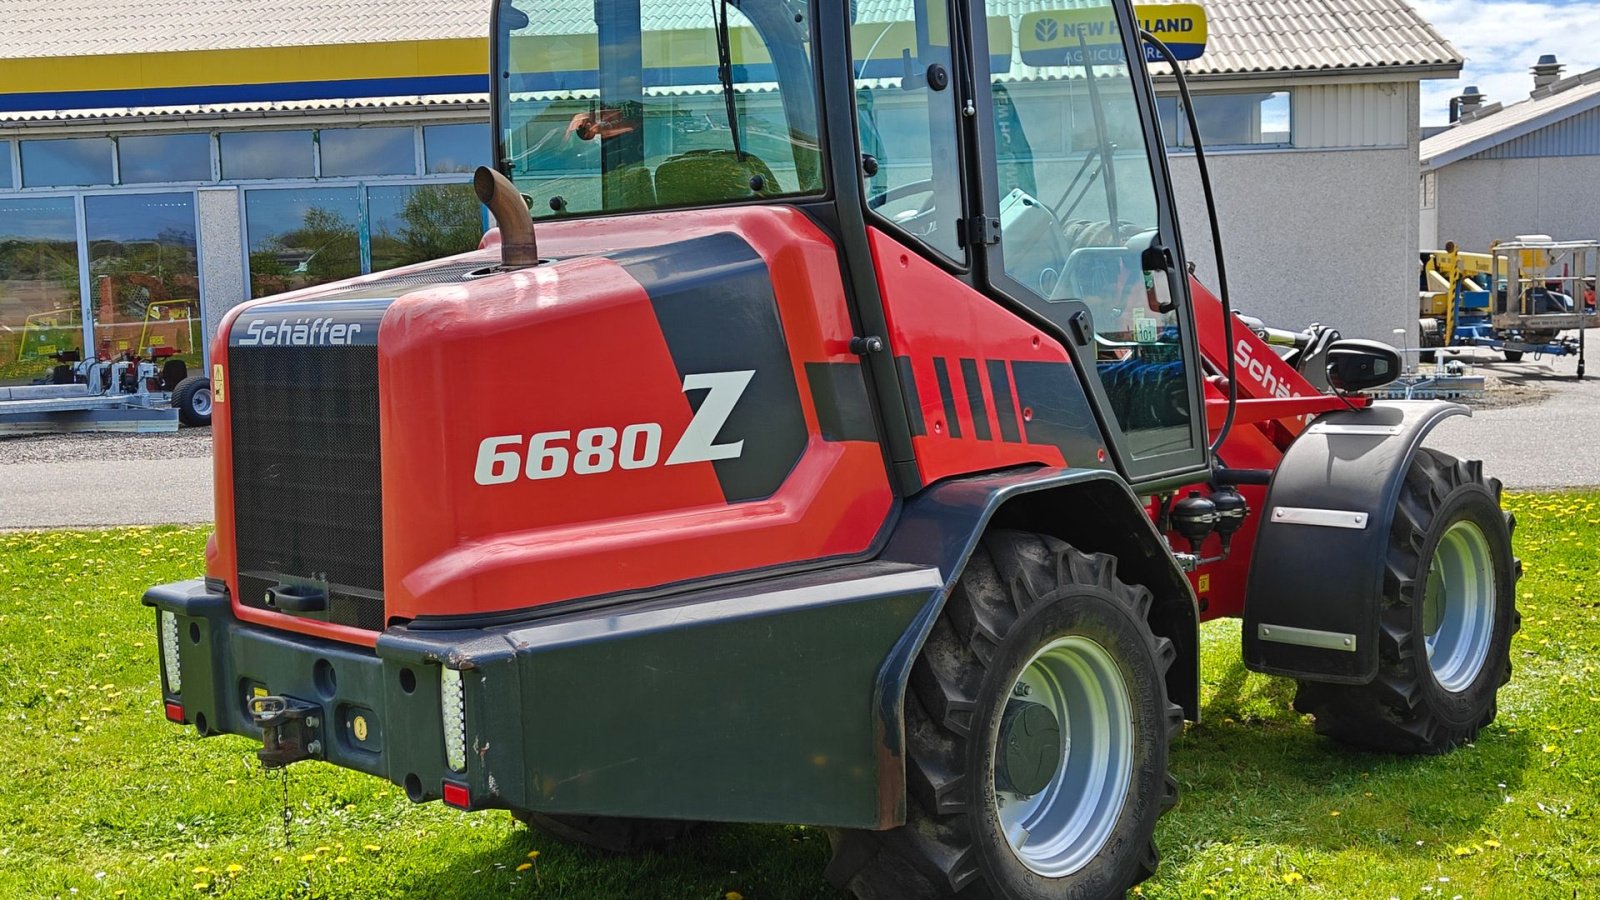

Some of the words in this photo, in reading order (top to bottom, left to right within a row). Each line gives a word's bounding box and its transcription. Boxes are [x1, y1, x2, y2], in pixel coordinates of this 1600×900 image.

[1063, 21, 1104, 38] NEW
[1110, 18, 1193, 36] HLAND
[1064, 47, 1164, 63] AGICULRE
[239, 317, 361, 345] Schäffer
[474, 423, 662, 486] 6680
[664, 369, 756, 466] Z
